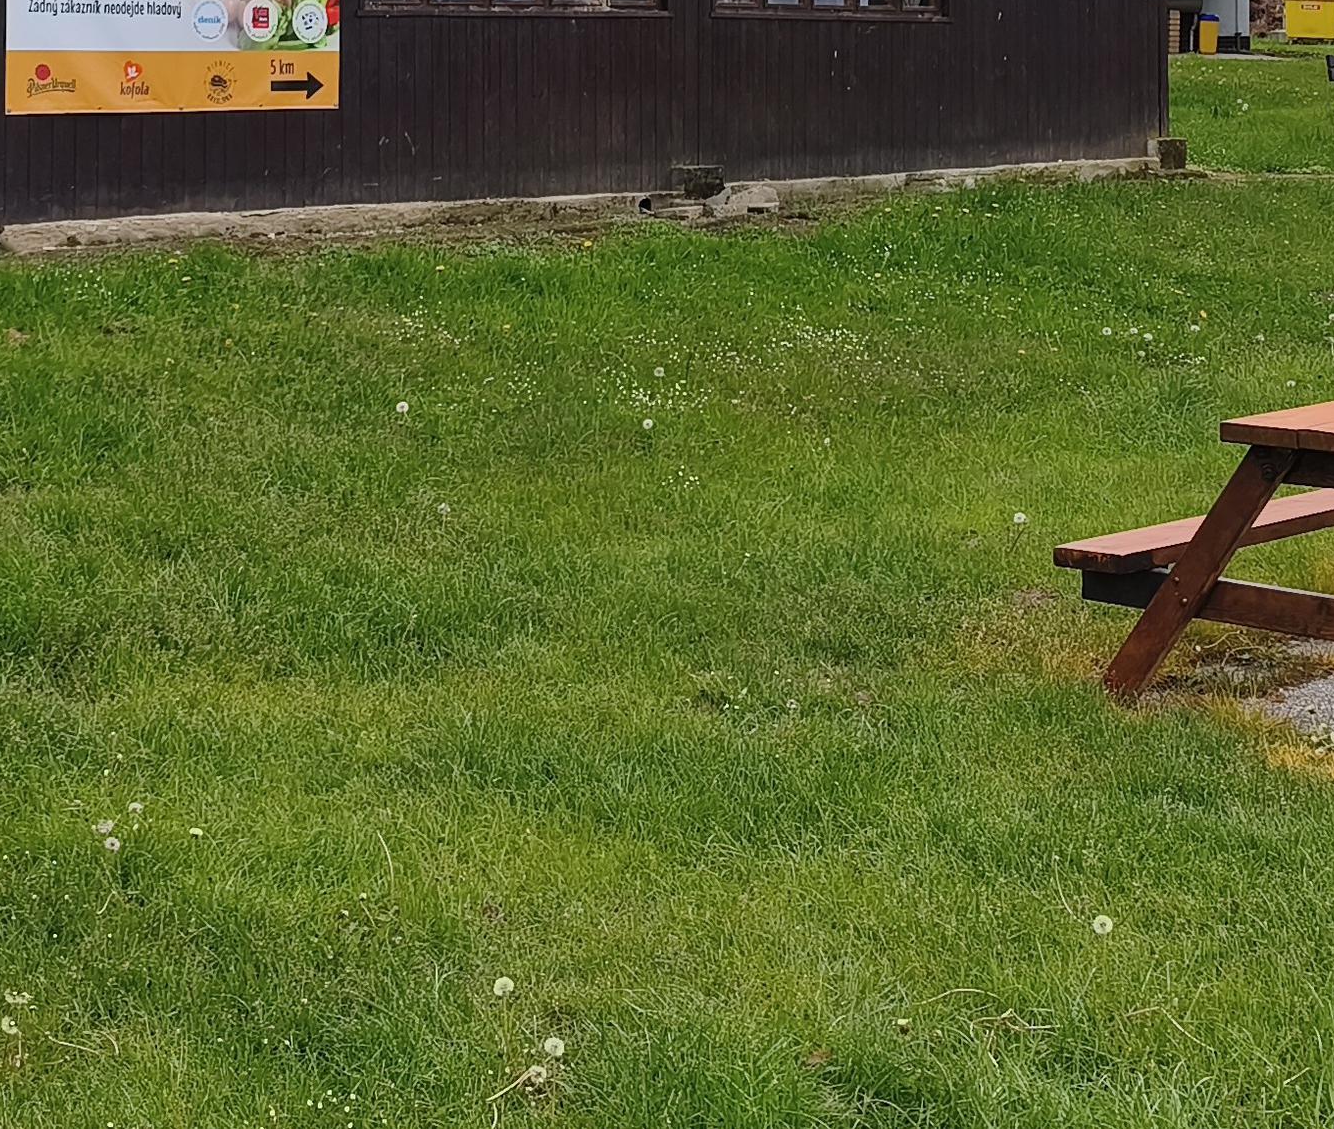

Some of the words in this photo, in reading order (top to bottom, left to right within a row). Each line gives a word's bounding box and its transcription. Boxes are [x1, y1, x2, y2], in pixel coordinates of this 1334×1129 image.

[103, 0, 145, 18] neodejde
[146, 1, 182, 19] hladový
[270, 59, 277, 75] 5
[278, 58, 295, 75] km
[120, 81, 150, 100] kofola
